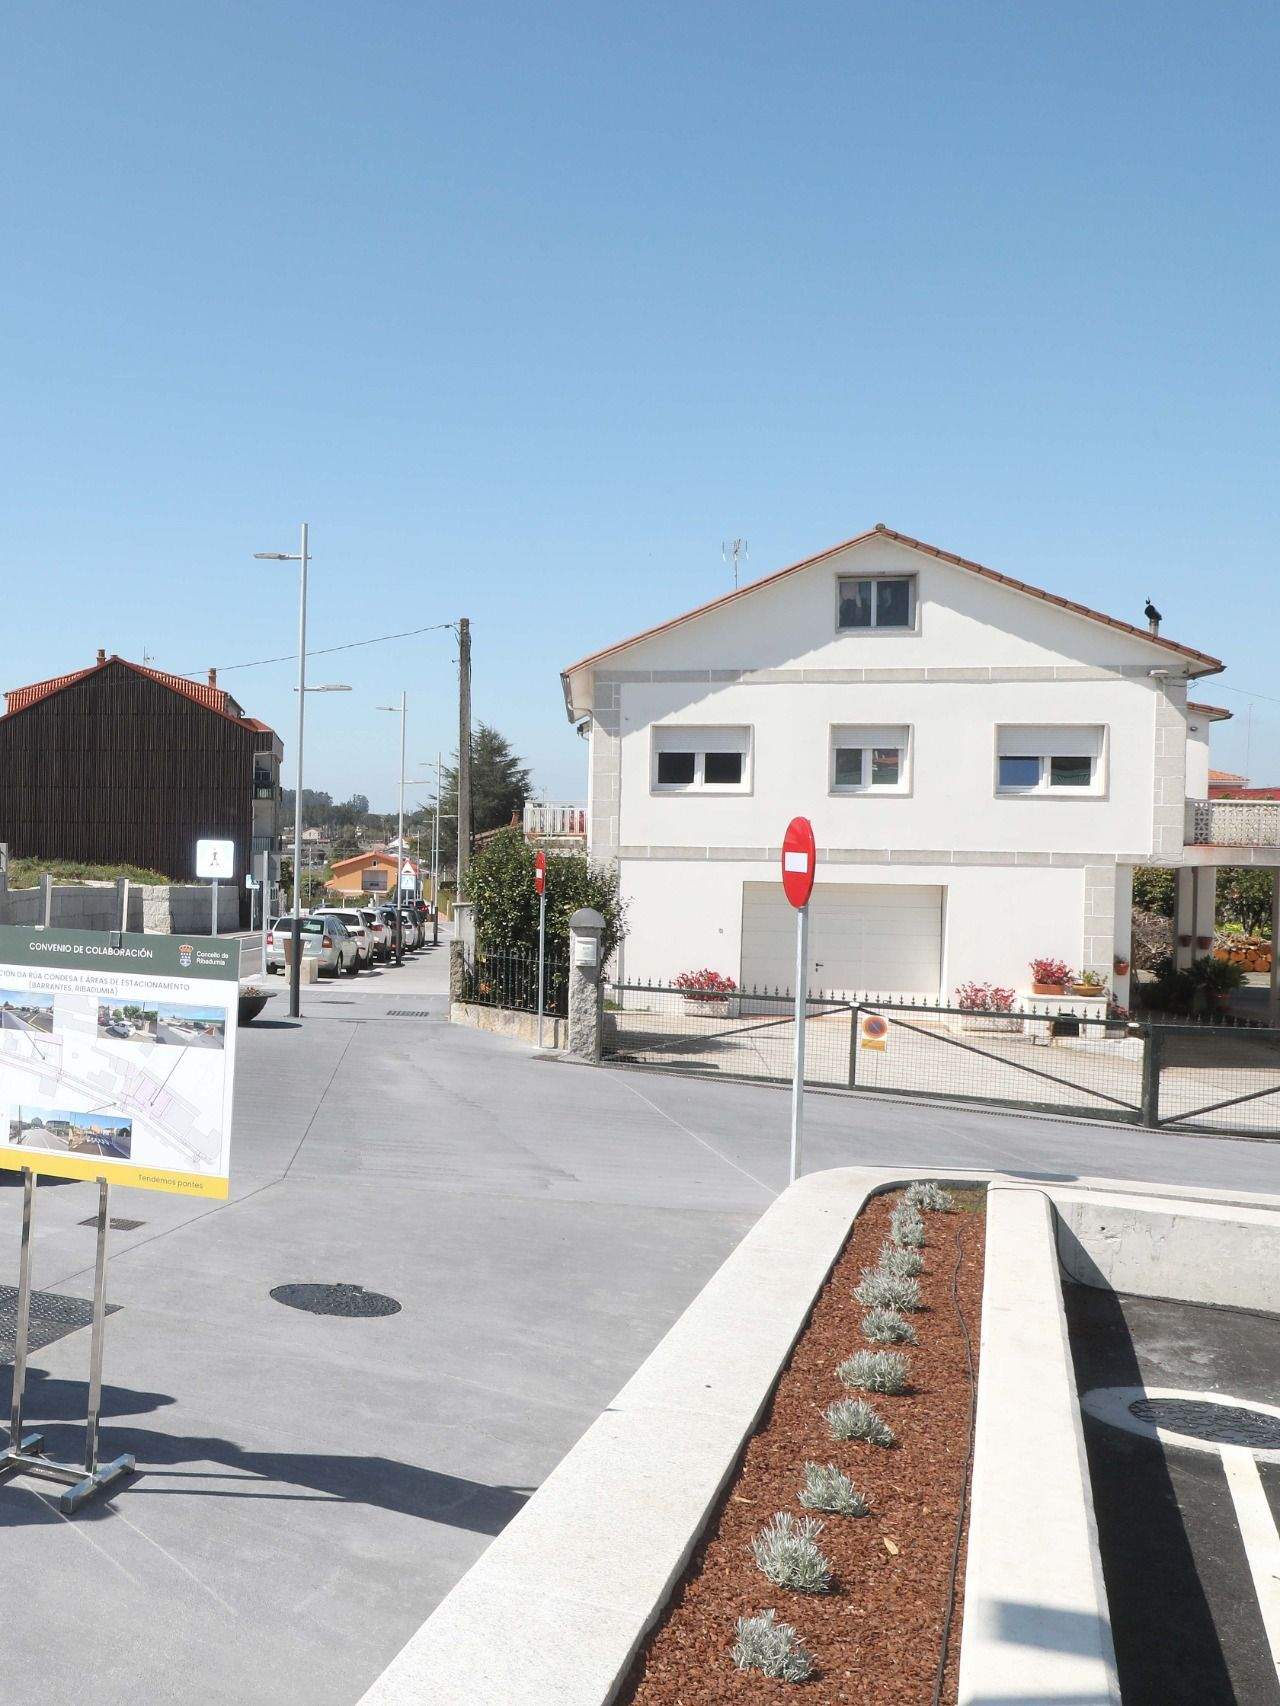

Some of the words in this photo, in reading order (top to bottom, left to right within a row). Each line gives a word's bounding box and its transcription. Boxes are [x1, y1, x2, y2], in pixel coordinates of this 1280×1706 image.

[29, 942, 71, 953] CONVENIO
[73, 945, 84, 954] DE
[85, 947, 153, 958] COLABORACIÓN
[196, 951, 220, 959] Concello
[196, 958, 226, 966] Ribadumia
[44, 973, 78, 982] CONDESA
[121, 978, 190, 991] ESTACIONAMENTO
[75, 986, 118, 996] RIBADUMIA)
[138, 1174, 176, 1186] Tendemos
[177, 1180, 204, 1190] pontes
